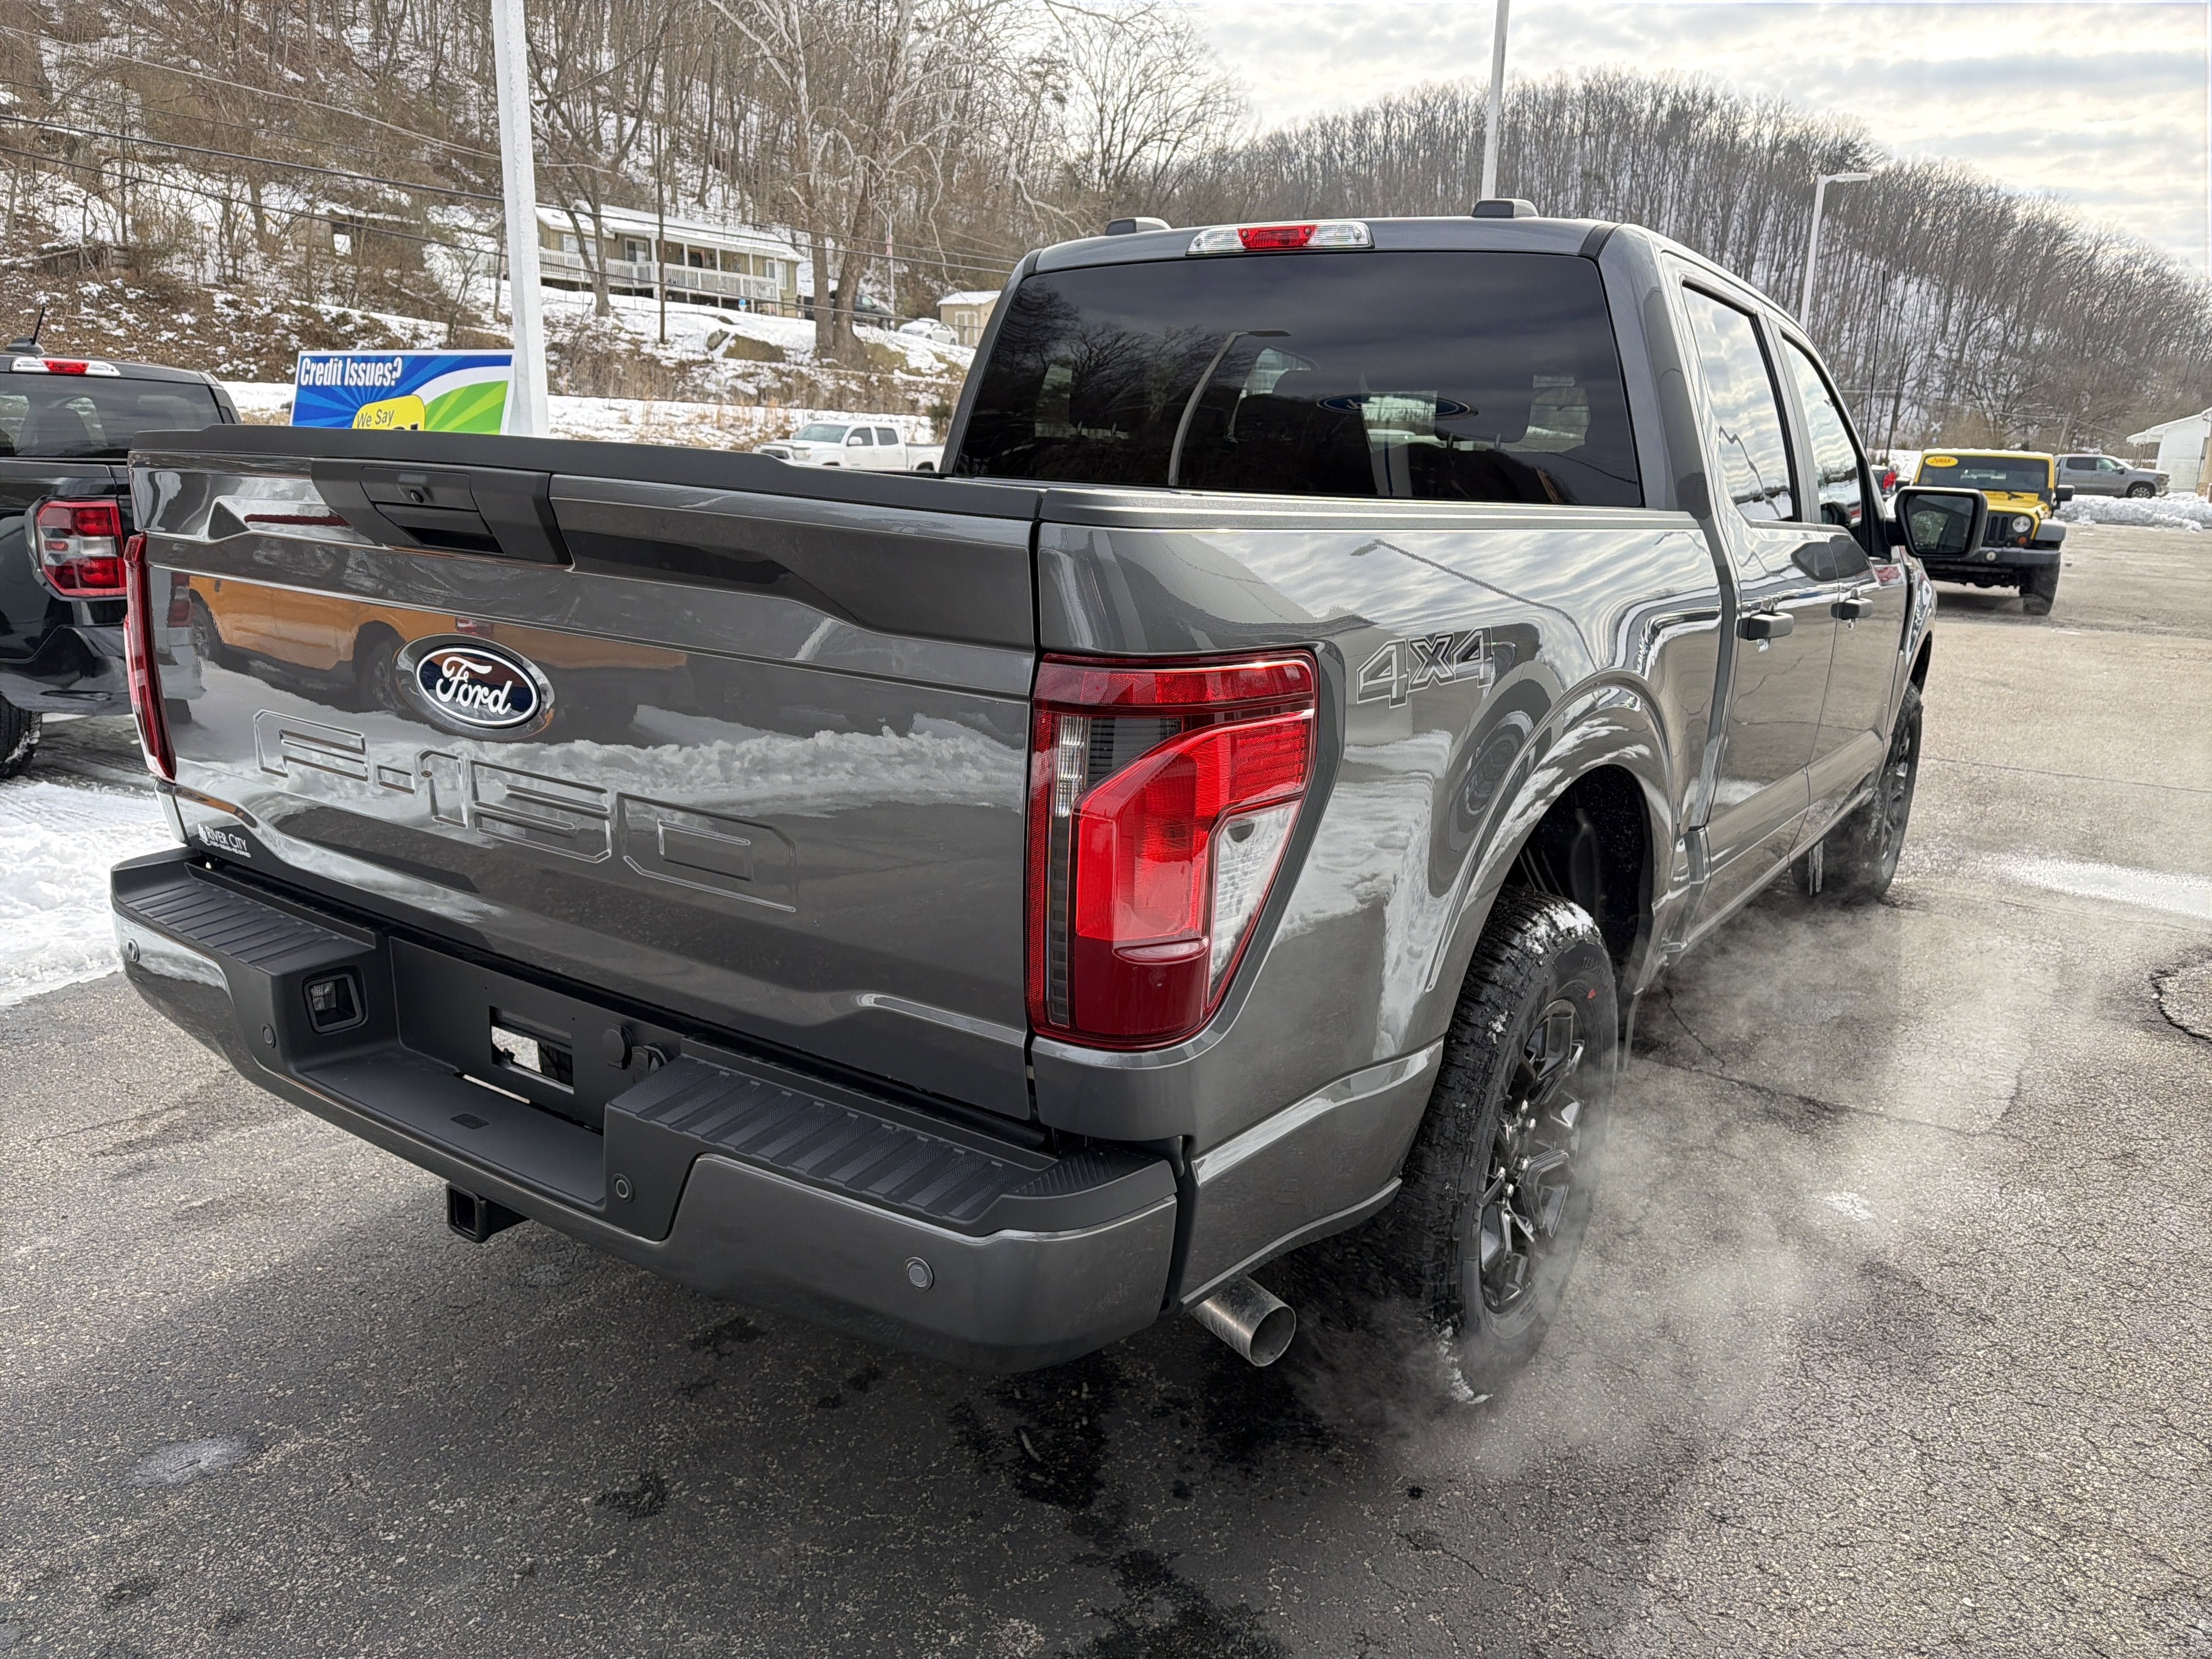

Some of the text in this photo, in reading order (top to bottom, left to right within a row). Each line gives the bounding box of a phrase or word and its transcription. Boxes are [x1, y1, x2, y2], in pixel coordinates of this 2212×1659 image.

[301, 357, 402, 386] Credit Issues?
[357, 412, 372, 428] We
[375, 409, 394, 427] Say
[436, 656, 513, 714] Ford
[253, 709, 799, 912] F-150
[205, 825, 229, 845] RIVER
[228, 833, 247, 851] CITY
